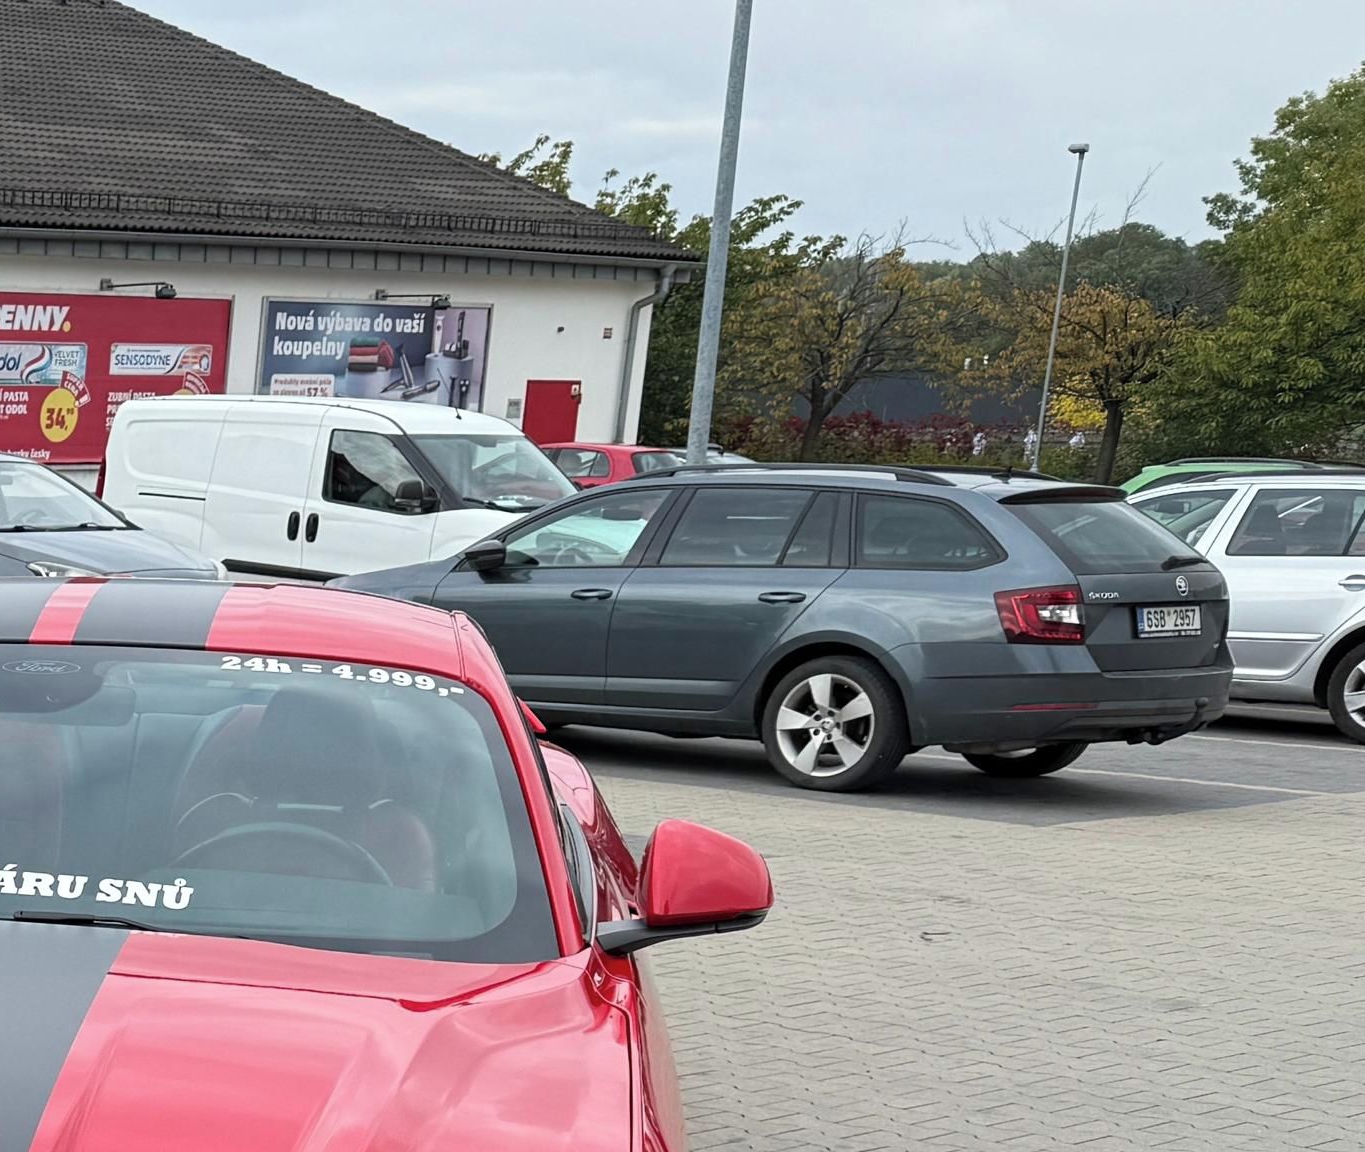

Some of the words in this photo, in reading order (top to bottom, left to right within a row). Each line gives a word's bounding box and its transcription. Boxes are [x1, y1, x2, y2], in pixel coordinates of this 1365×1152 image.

[275, 309, 315, 330] Nová
[317, 311, 370, 334] výbava
[373, 313, 392, 332] do
[395, 312, 426, 333] vaší
[273, 336, 345, 360] koupelny
[114, 353, 171, 366] SENSODYNE
[3, 391, 29, 402] PASTA
[8, 405, 28, 415] ODOL
[1146, 609, 1166, 629] 6SB
[1173, 608, 1196, 627] 2957
[15, 661, 68, 673] Ford
[220, 655, 292, 674] 24h
[302, 663, 322, 673] =
[331, 664, 464, 697] 4.999,-
[95, 877, 195, 910] SNŮ
